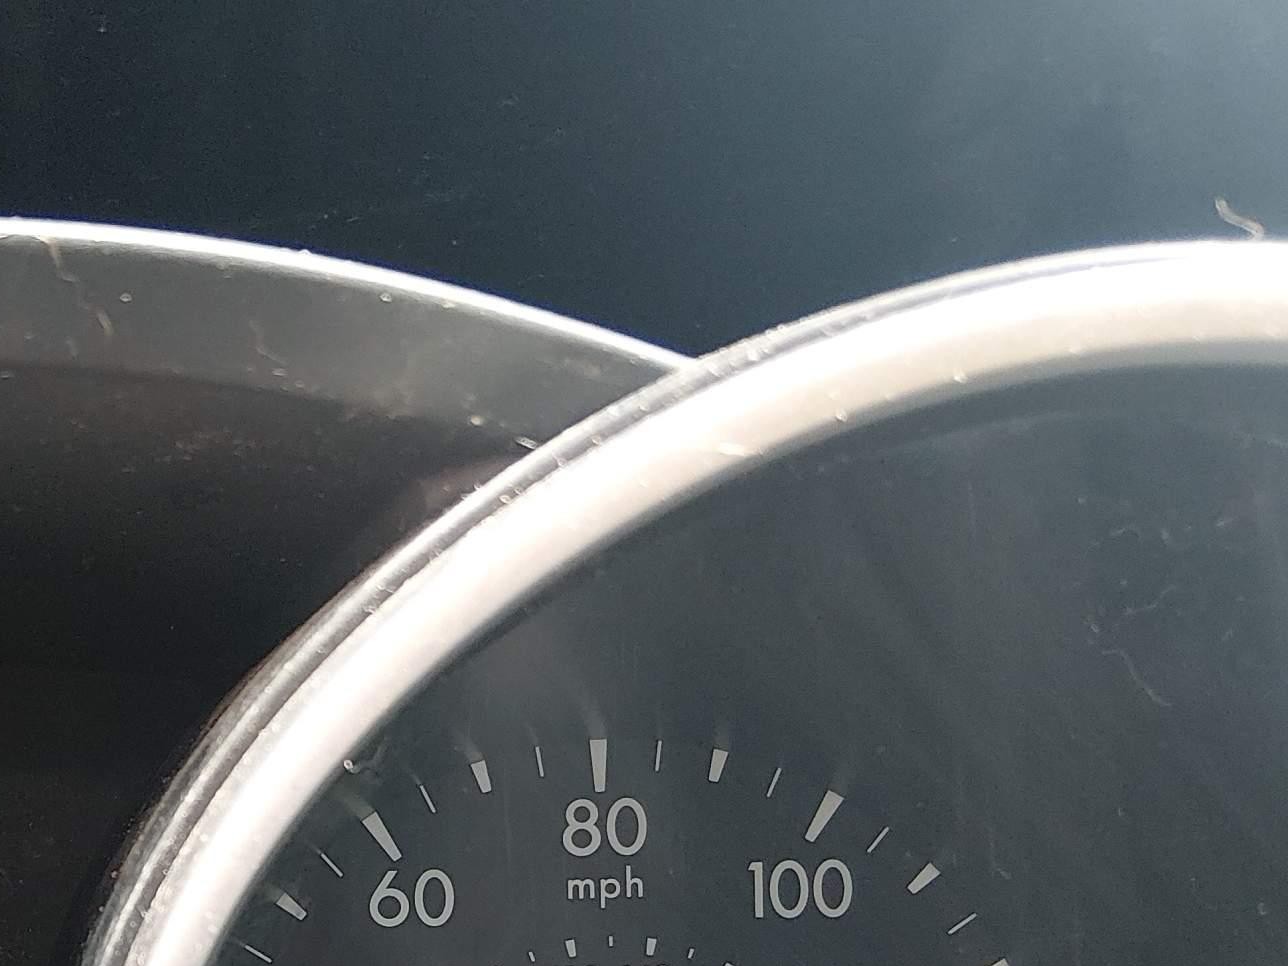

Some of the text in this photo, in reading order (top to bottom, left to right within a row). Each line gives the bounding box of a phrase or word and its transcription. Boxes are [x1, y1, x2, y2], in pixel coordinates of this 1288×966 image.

[562, 797, 647, 857] 80
[369, 869, 455, 927] 60
[567, 865, 644, 909] mph
[748, 859, 853, 919] 100
